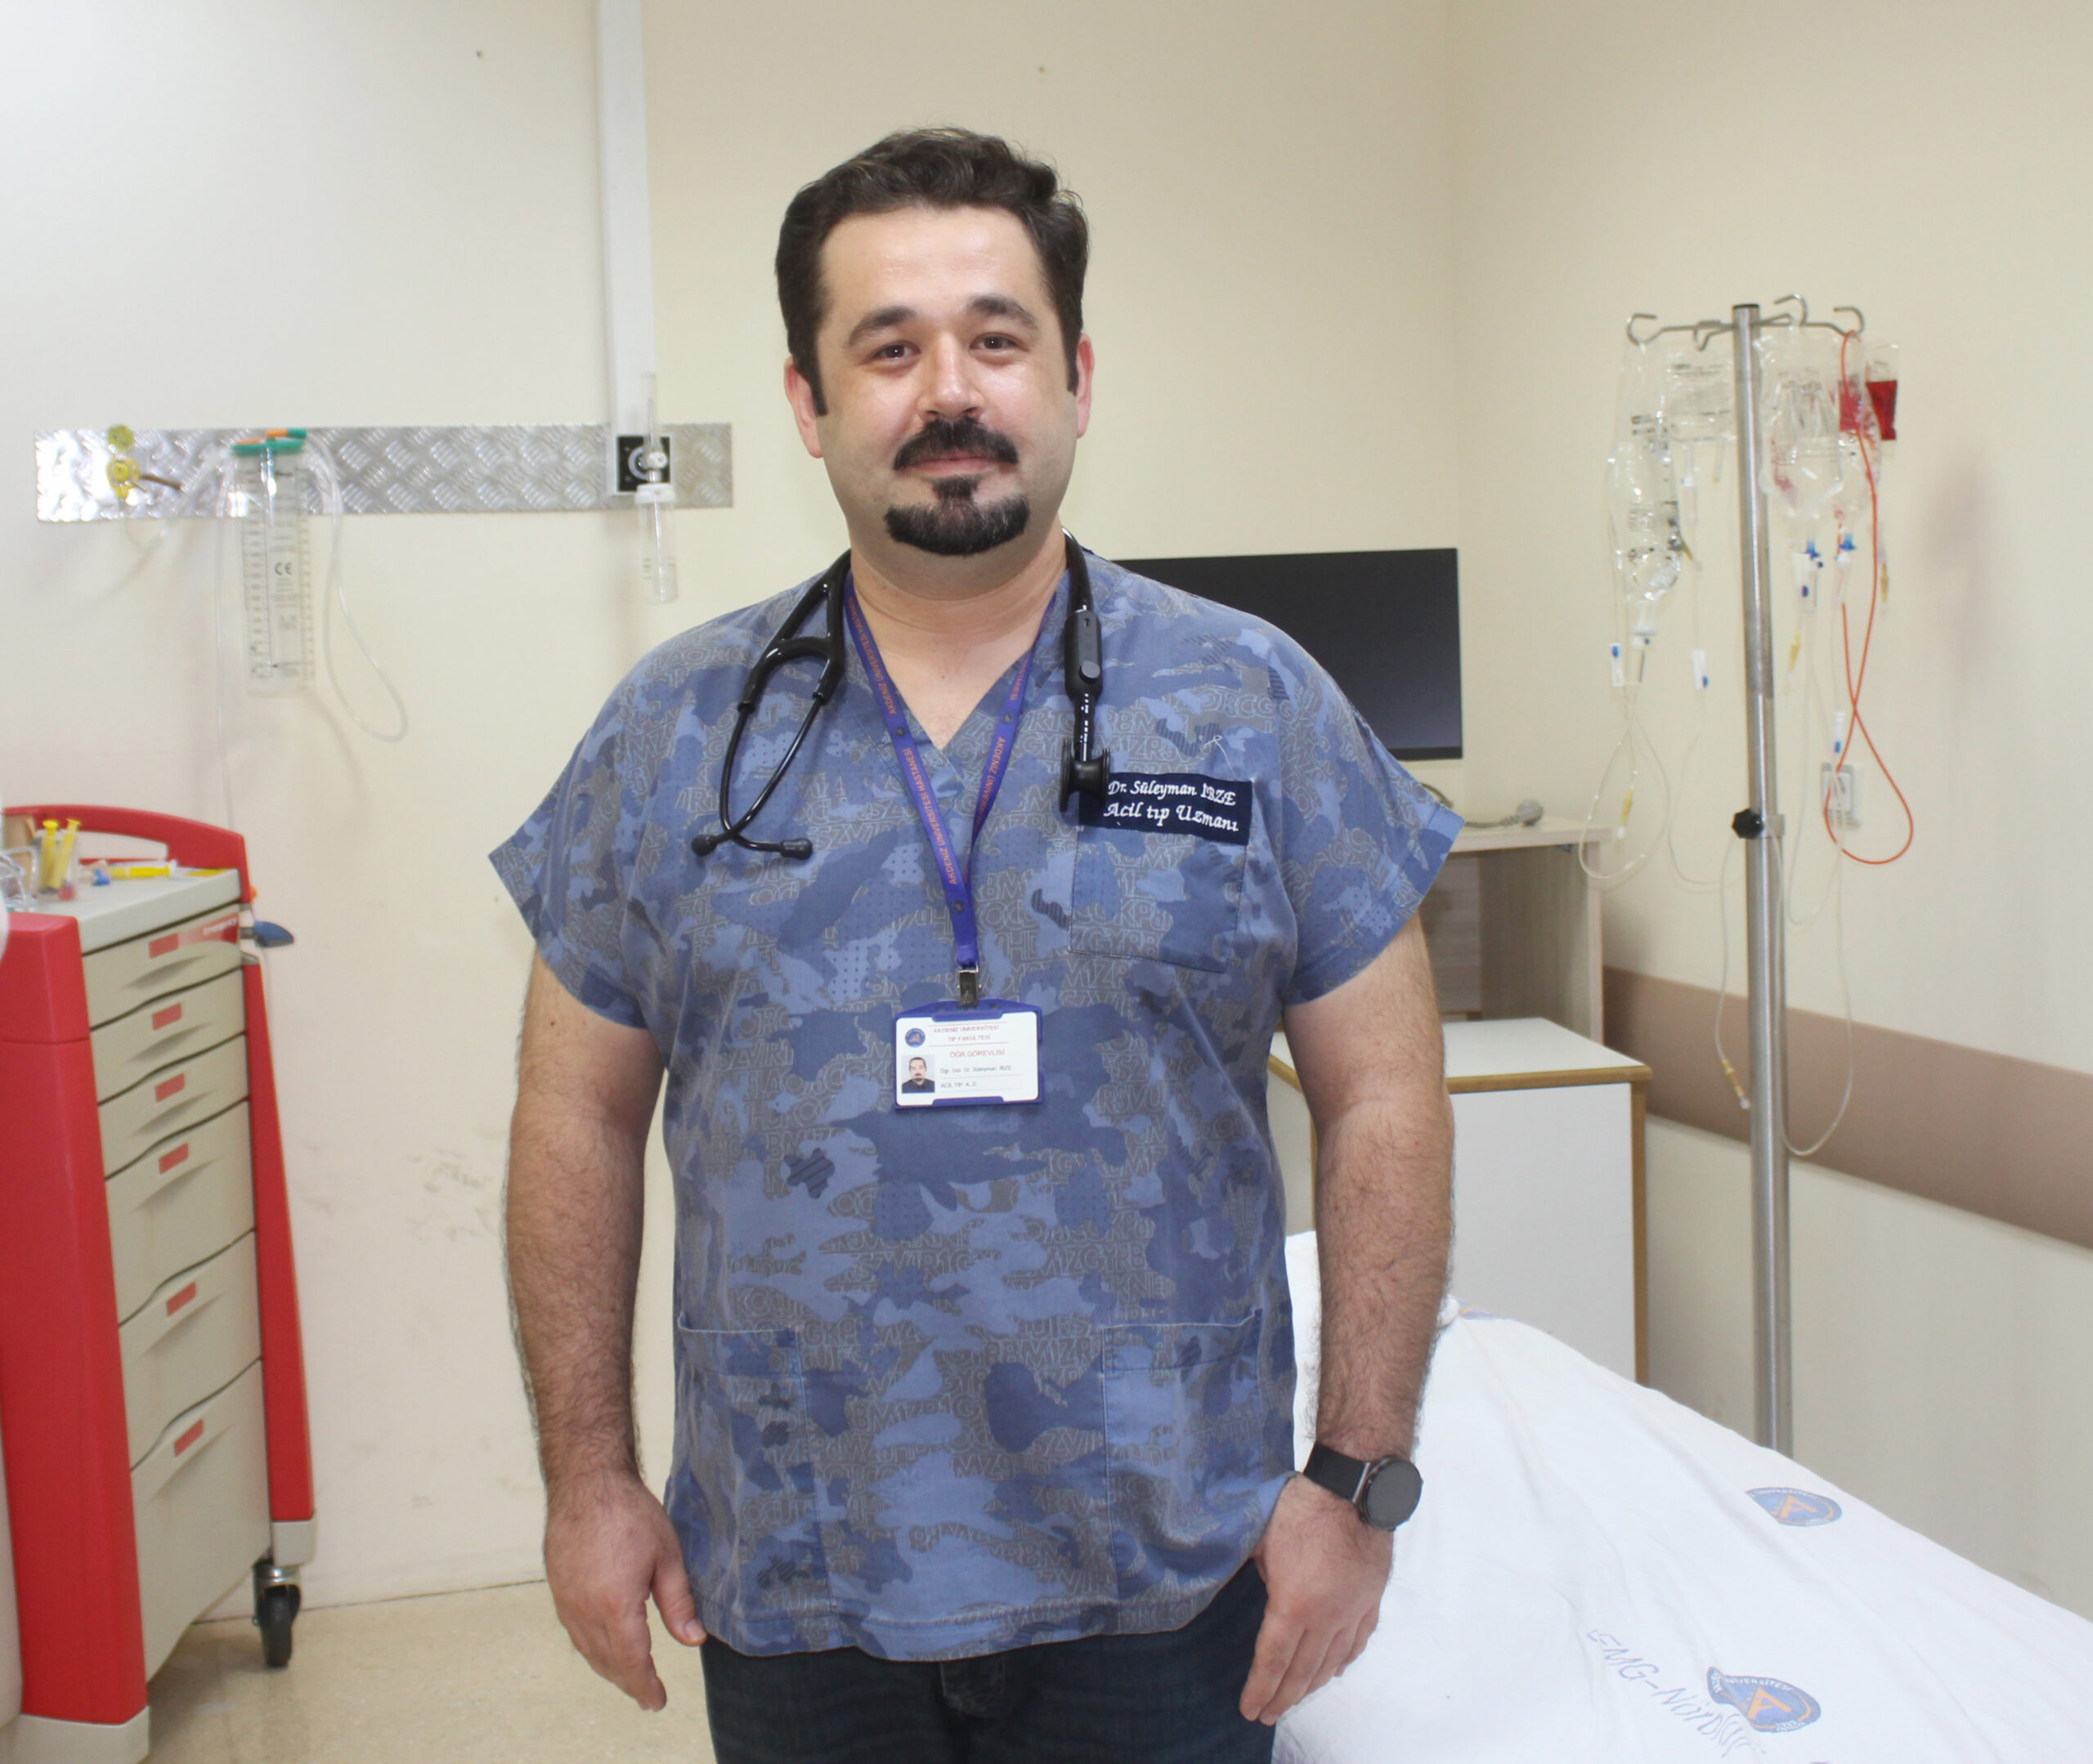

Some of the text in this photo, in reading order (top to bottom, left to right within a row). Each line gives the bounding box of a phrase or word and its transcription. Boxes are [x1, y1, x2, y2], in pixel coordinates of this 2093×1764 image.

[274, 562, 294, 575] CE
[988, 736, 1006, 774] AKDENİZ
[1108, 781, 1127, 795] Dr.
[1130, 780, 1197, 800] Süleyman
[1104, 802, 1239, 832] Acil tıp Uzmanı
[940, 847, 957, 885] AKDENİZ
